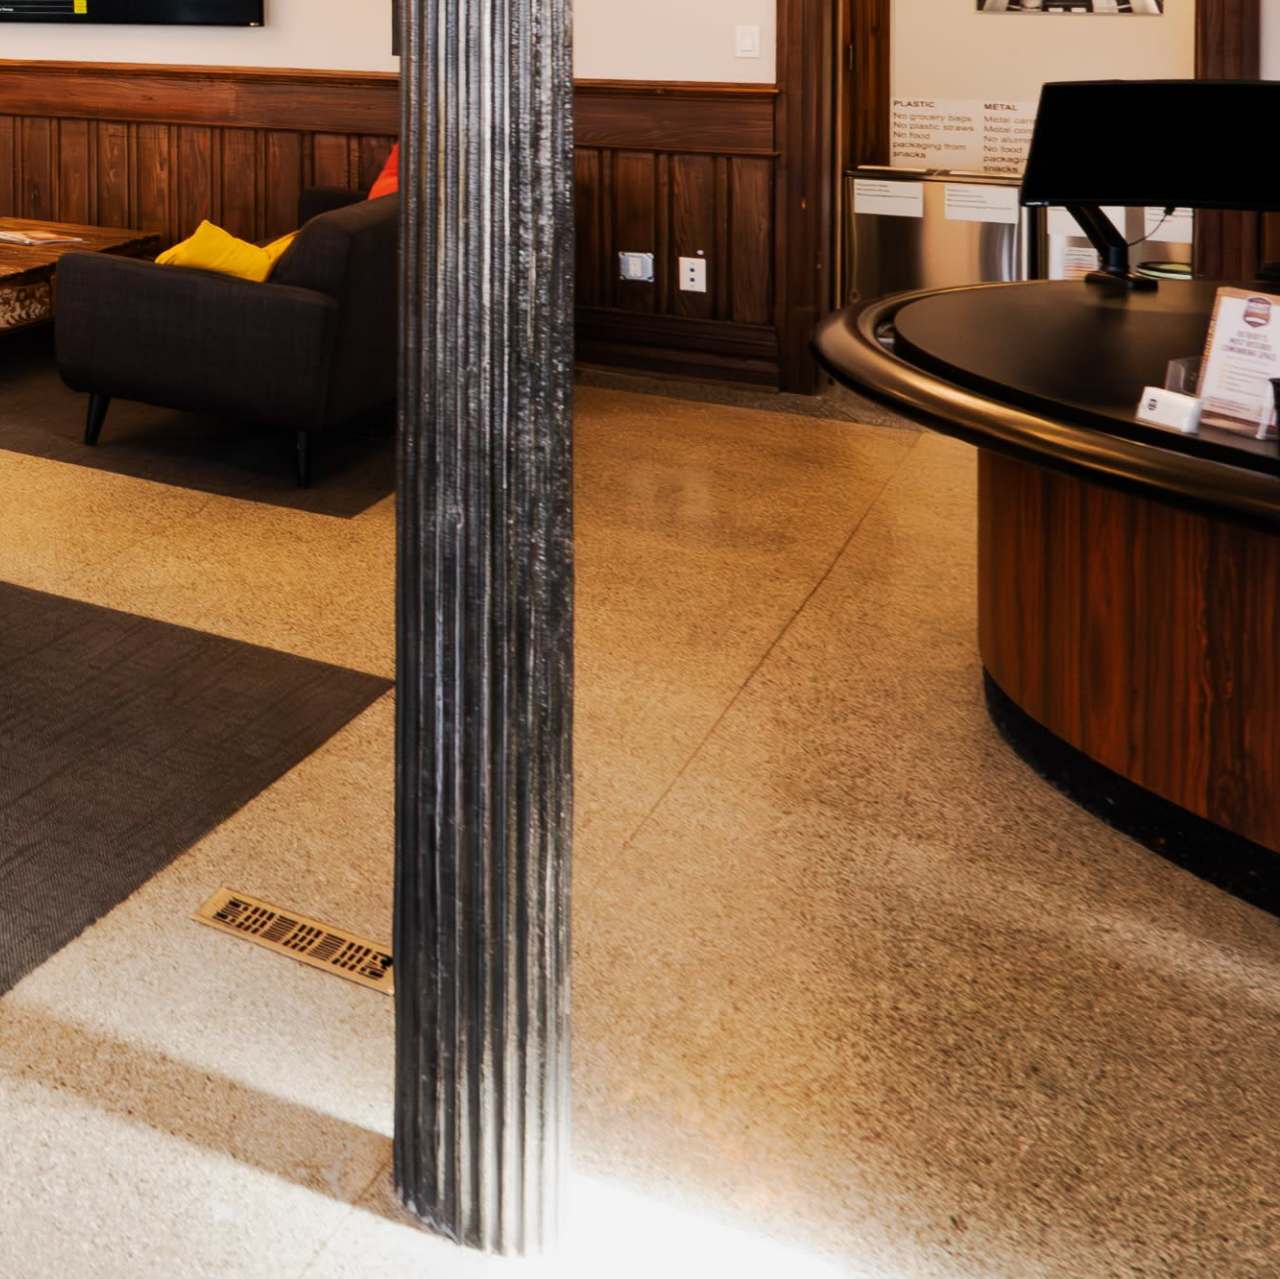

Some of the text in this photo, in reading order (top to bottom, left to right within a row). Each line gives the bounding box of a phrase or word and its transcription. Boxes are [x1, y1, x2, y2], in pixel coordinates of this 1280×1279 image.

[893, 100, 935, 108] PLASTIC
[983, 103, 1017, 111] METAL
[893, 112, 907, 120] No
[893, 121, 907, 129] No
[909, 131, 930, 140] food
[983, 135, 998, 143] No
[892, 142, 942, 151] packaging
[983, 145, 1022, 153] No food
[983, 165, 1019, 174] snacks
